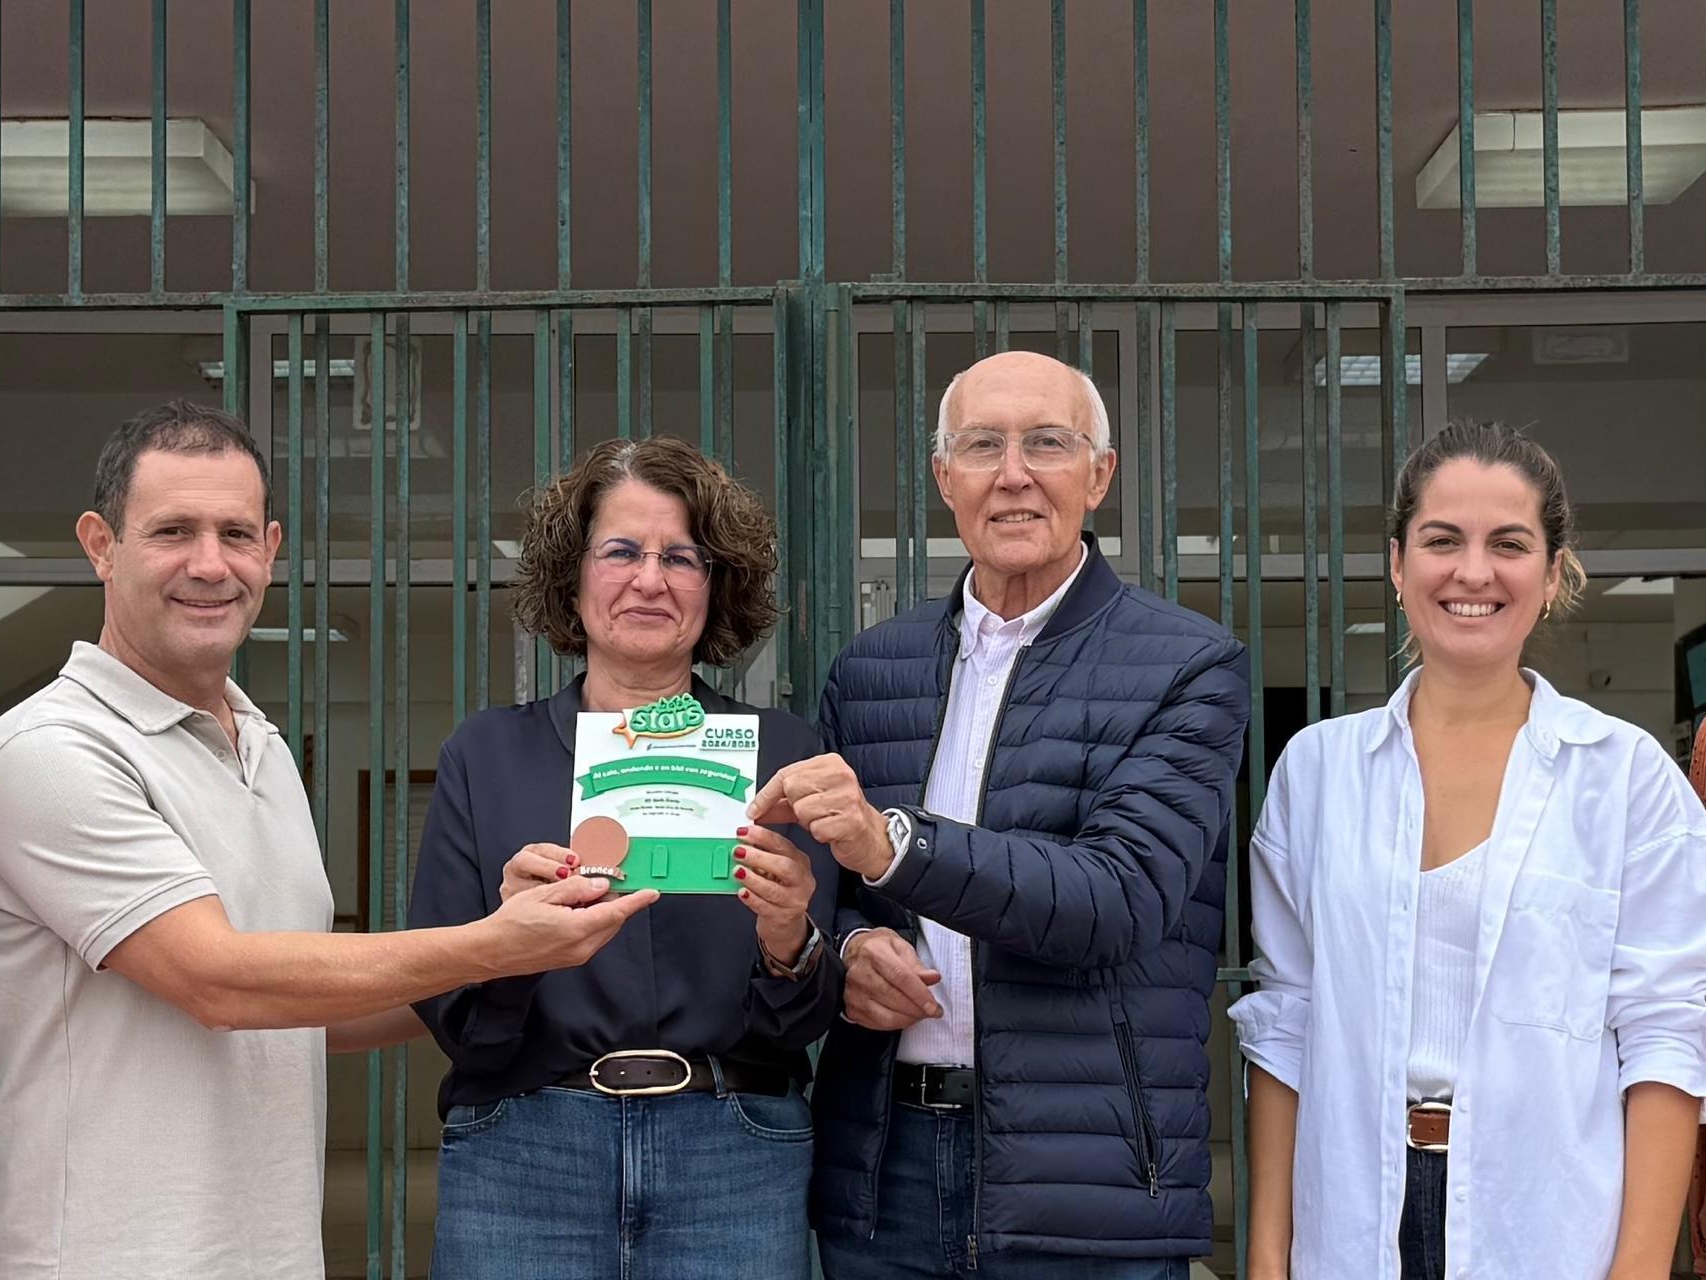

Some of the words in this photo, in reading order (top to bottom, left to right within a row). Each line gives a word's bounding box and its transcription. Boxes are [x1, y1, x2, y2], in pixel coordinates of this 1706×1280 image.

[633, 704, 702, 730] stars
[705, 728, 754, 739] CURSO
[580, 865, 614, 876] Bronce
